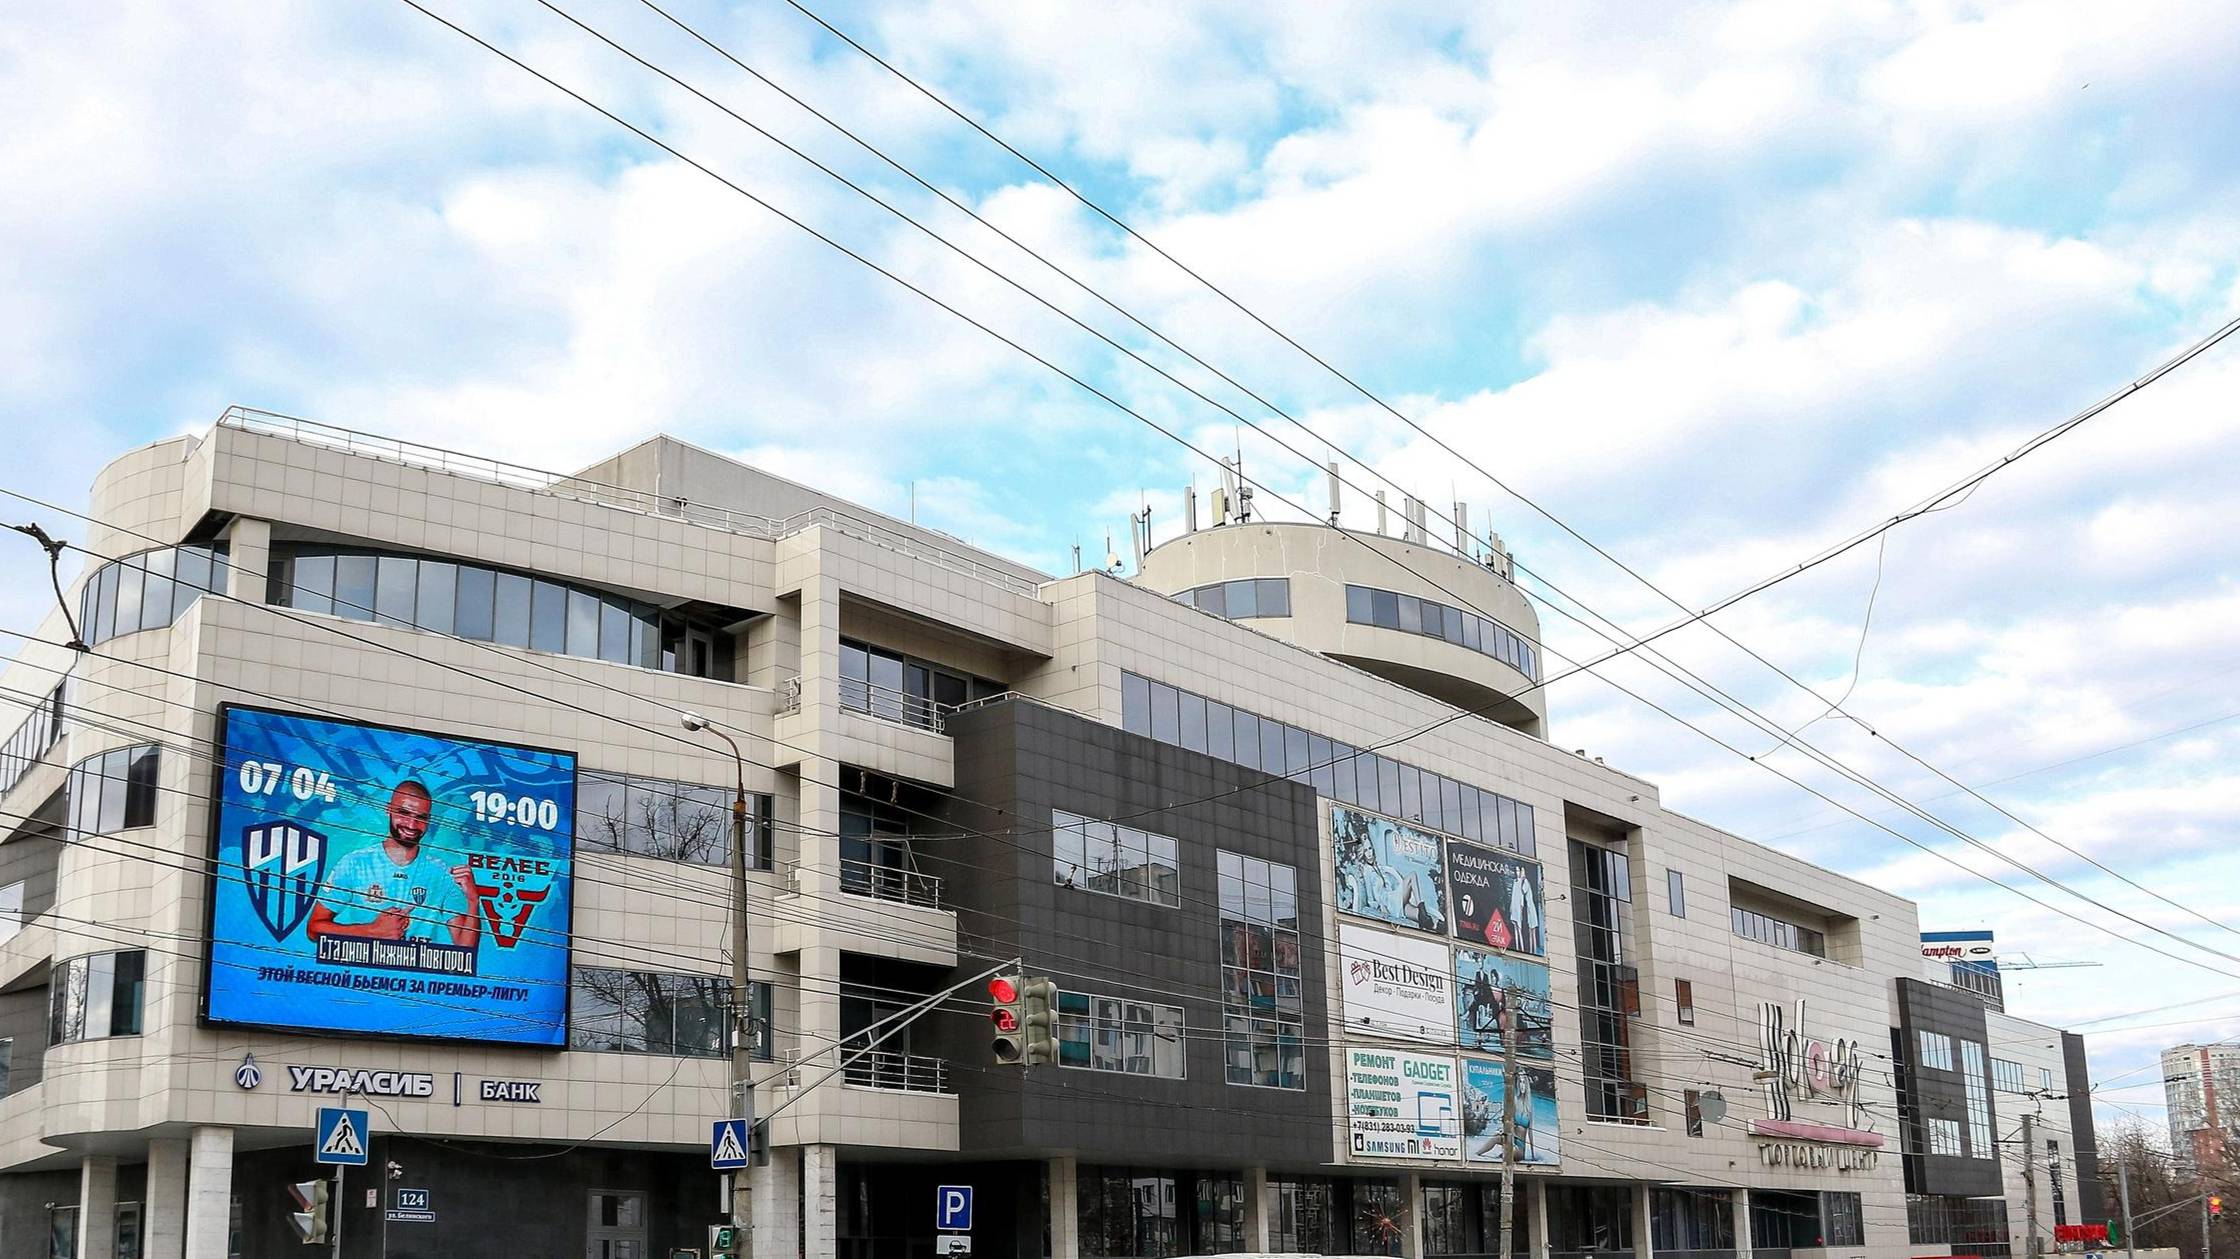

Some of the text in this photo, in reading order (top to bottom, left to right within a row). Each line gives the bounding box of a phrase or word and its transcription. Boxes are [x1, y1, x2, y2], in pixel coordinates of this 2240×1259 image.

[470, 791, 558, 831] 19:00
[468, 853, 550, 876] ВЕЛЕС
[1452, 853, 1509, 875] МЕДИЦИНСКАЯ
[492, 872, 525, 882] 2016
[1454, 870, 1490, 888] ОДЕЖДА
[319, 935, 473, 974] Стадион Нижний Новгород
[1920, 944, 1966, 959] ampton
[258, 964, 528, 1001] ЭТОЙ ВЕСНОЙ БЬЕМСЯ ЗА ПРЕМЬЕР-ЛИГУ!
[1373, 959, 1444, 992] Best Design
[1374, 983, 1445, 1004] Декор Подарки Посуда
[1354, 1053, 1395, 1069] РЕМОНТ
[1404, 1060, 1450, 1081] GADGET
[288, 1066, 541, 1103] УРАЛСИБ БАНК
[1353, 1121, 1379, 1133] +7(831)
[1367, 1141, 1405, 1154] SAMSUNG
[1434, 1144, 1458, 1156] honor
[401, 1193, 425, 1206] 124
[946, 1191, 965, 1224] P
